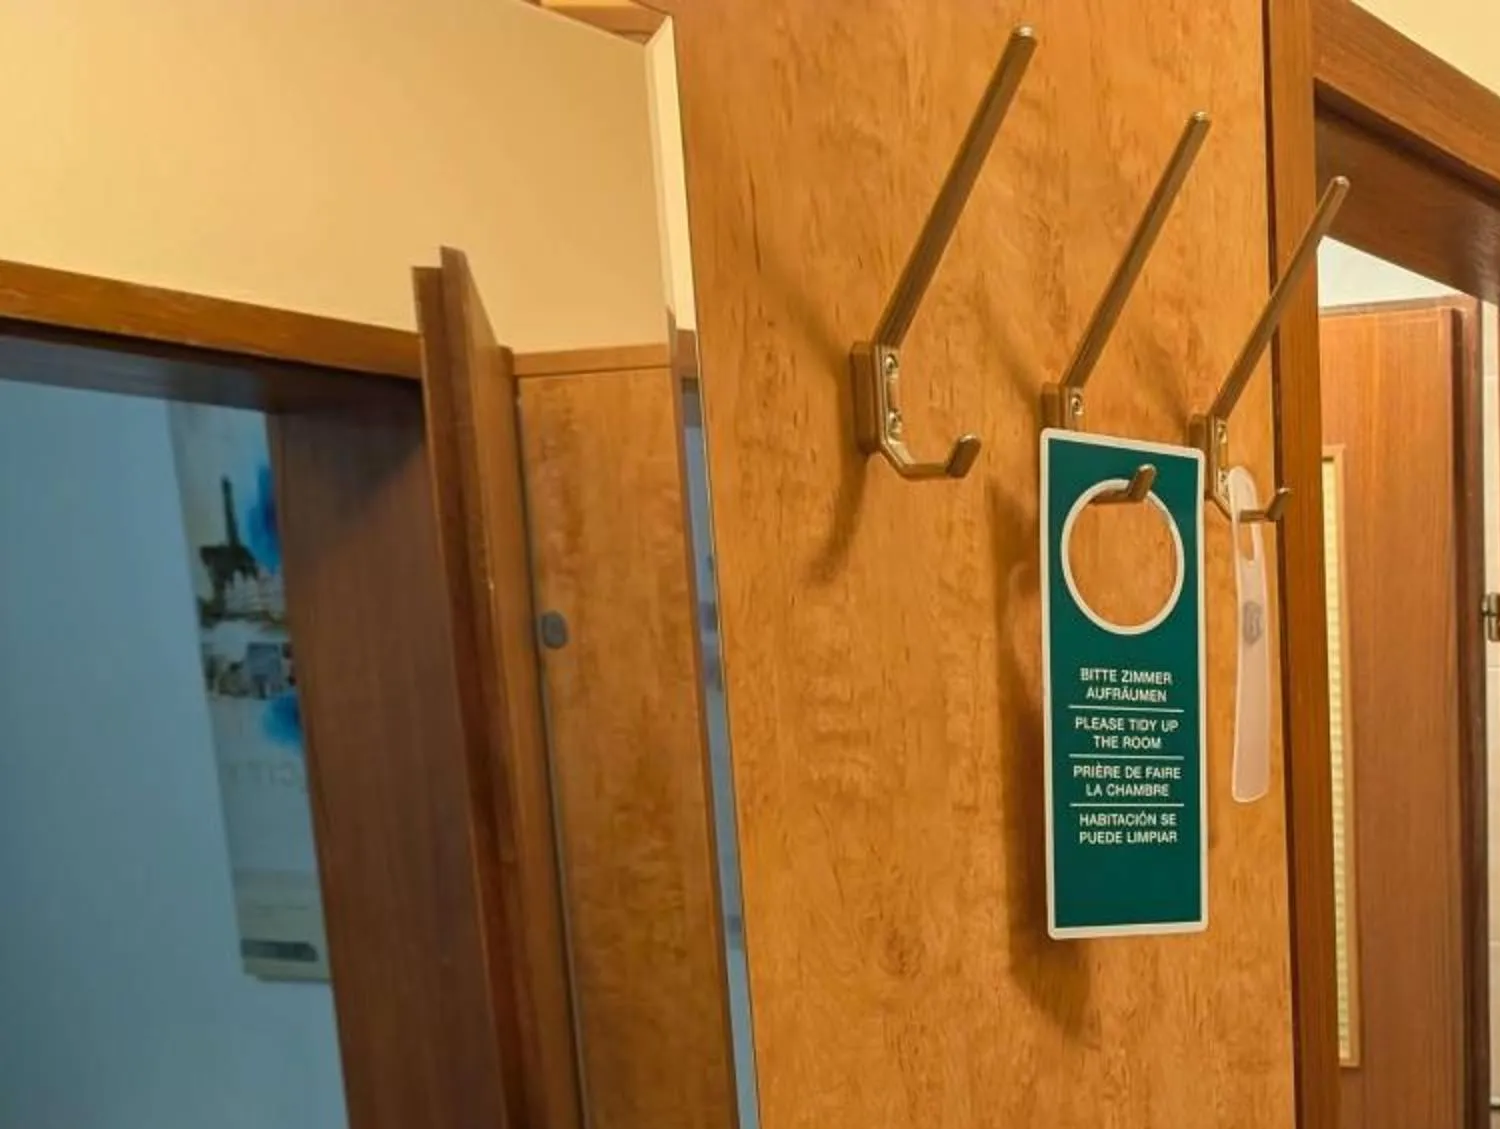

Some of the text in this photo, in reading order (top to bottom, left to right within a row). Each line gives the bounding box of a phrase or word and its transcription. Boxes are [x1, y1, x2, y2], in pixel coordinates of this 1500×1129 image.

[1080, 667, 1173, 685] BITTE ZIMMER
[1086, 685, 1167, 702] AUFRÄUMEN
[1075, 716, 1179, 733] PLEASE TIDY UP
[1093, 735, 1162, 749] THE ROOM
[1073, 762, 1181, 779] PRIÈRE DE FAIRE
[1085, 783, 1169, 797] LA CHAMBRE
[1079, 810, 1177, 827] HABITACIÓN SE
[1079, 831, 1177, 844] PUEDE LIMPIAR
